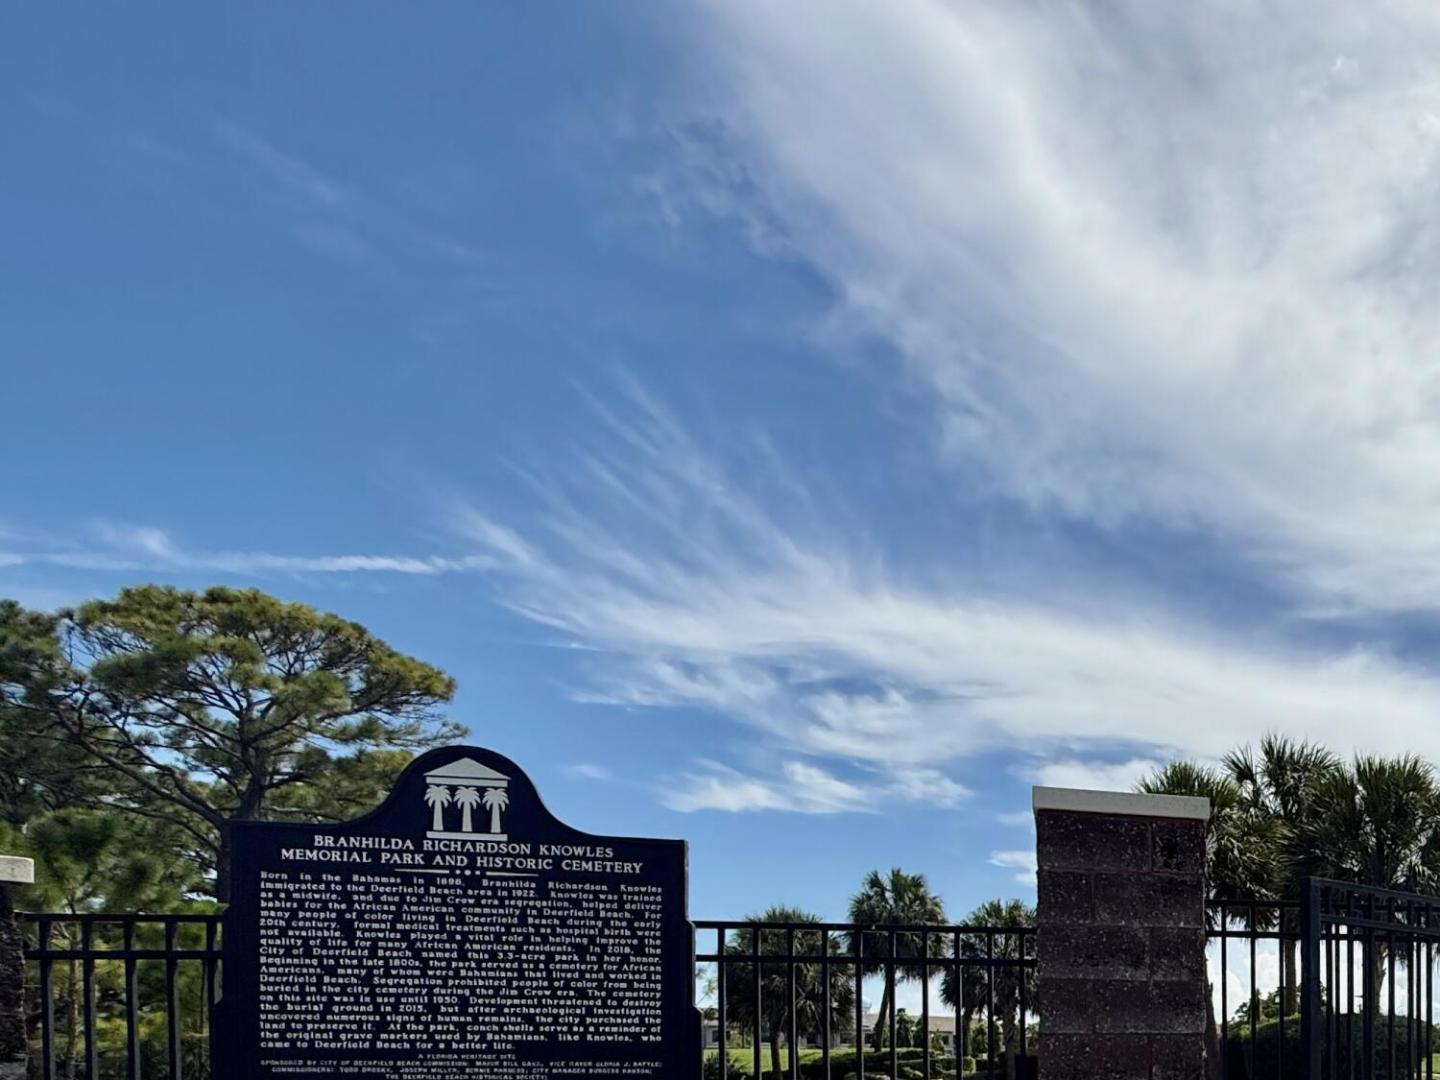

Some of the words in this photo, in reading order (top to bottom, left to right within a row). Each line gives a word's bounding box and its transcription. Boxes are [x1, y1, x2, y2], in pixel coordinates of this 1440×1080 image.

[314, 834, 414, 850] BRANHILDA
[423, 838, 530, 854] RICHARDSON
[539, 844, 613, 857] KNOWLES
[281, 848, 371, 862] MEMORIAL
[380, 852, 424, 864] PARK
[432, 854, 467, 866] AND
[476, 856, 552, 869] HISTORIC
[561, 859, 642, 873] CEMETERY
[260, 871, 287, 879] Born
[300, 872, 311, 880] in
[322, 873, 340, 881] the
[352, 874, 400, 883] Bahamas
[413, 876, 424, 884] in
[482, 878, 535, 887] Branhilda
[548, 881, 607, 890] Richardson
[620, 884, 661, 892] Knowles
[260, 899, 297, 908] babies
[353, 902, 396, 910] African
[402, 904, 454, 912] American
[461, 904, 520, 915] community
[543, 908, 593, 916] Deerfield
[645, 909, 661, 919] For
[259, 918, 285, 926] 20th
[354, 920, 390, 929] formal
[396, 921, 438, 930] medical
[445, 923, 505, 932] treatments
[511, 925, 534, 933] such
[556, 926, 598, 935] hospital
[636, 927, 660, 936] were
[260, 910, 290, 918] many
[298, 910, 336, 919] people
[344, 911, 356, 919] of
[363, 912, 393, 920] color
[402, 913, 435, 922] living
[465, 913, 518, 923] Deerfield
[527, 916, 559, 924] Beach
[566, 918, 602, 926] during
[633, 920, 660, 928] early
[259, 936, 302, 946] quality
[327, 938, 347, 946] life
[354, 939, 371, 947] for
[377, 941, 407, 949] many
[414, 940, 457, 949] African
[464, 942, 515, 950] American
[356, 930, 400, 938] Knowles
[410, 931, 447, 940] played
[468, 933, 493, 941] vital
[548, 934, 587, 944] helping
[596, 936, 637, 945] improve
[259, 946, 285, 955] City
[312, 947, 368, 956] Deerfield
[377, 949, 411, 957] Beach
[421, 950, 457, 958] named
[554, 953, 579, 961] park
[603, 954, 621, 962] her
[259, 955, 317, 965] Beginning
[451, 960, 476, 968] park
[549, 960, 598, 970] cemetery
[621, 963, 661, 971] African
[373, 967, 384, 975] of
[460, 968, 517, 977] Bahamians
[552, 970, 578, 978] lived
[584, 970, 603, 978] and
[259, 974, 316, 982] Deerfield
[372, 976, 442, 986] Segregation
[448, 978, 506, 987] prohibited
[512, 979, 548, 988] people
[603, 980, 627, 988] from
[633, 981, 661, 989] being
[286, 1002, 323, 1010] burial
[332, 1004, 373, 1013] ground
[503, 1005, 585, 1015] archaeological
[593, 1006, 661, 1016] investigation
[259, 1012, 319, 1020] uncovered
[326, 1012, 380, 1020] numerous
[386, 1013, 414, 1022] signs
[558, 1014, 579, 1023] city
[585, 1015, 639, 1024] purchased
[286, 1031, 332, 1040] original
[466, 1033, 480, 1041] by
